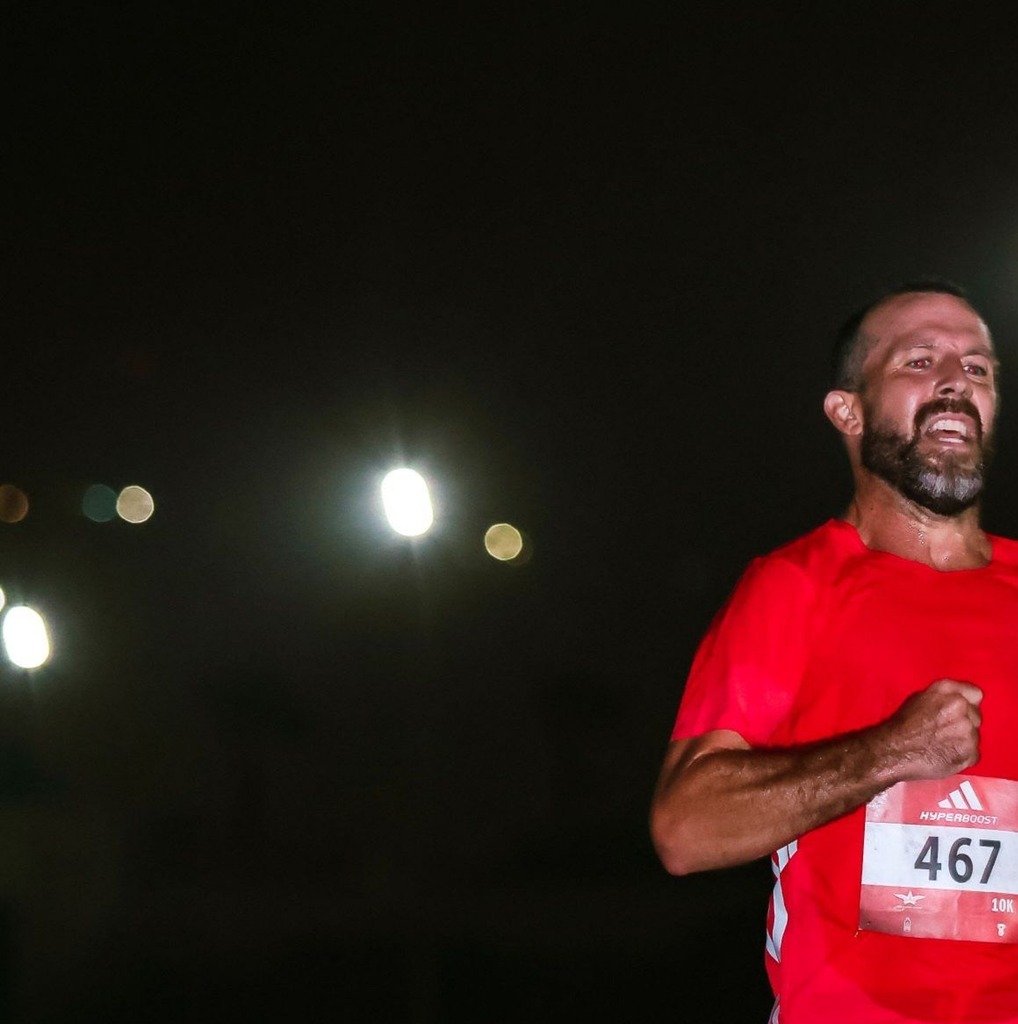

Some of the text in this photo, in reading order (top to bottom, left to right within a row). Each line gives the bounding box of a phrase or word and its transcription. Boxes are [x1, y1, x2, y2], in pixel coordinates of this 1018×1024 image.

[920, 811, 998, 825] HYPERBOOST
[914, 836, 1002, 884] 467
[991, 898, 1014, 913] 10K
